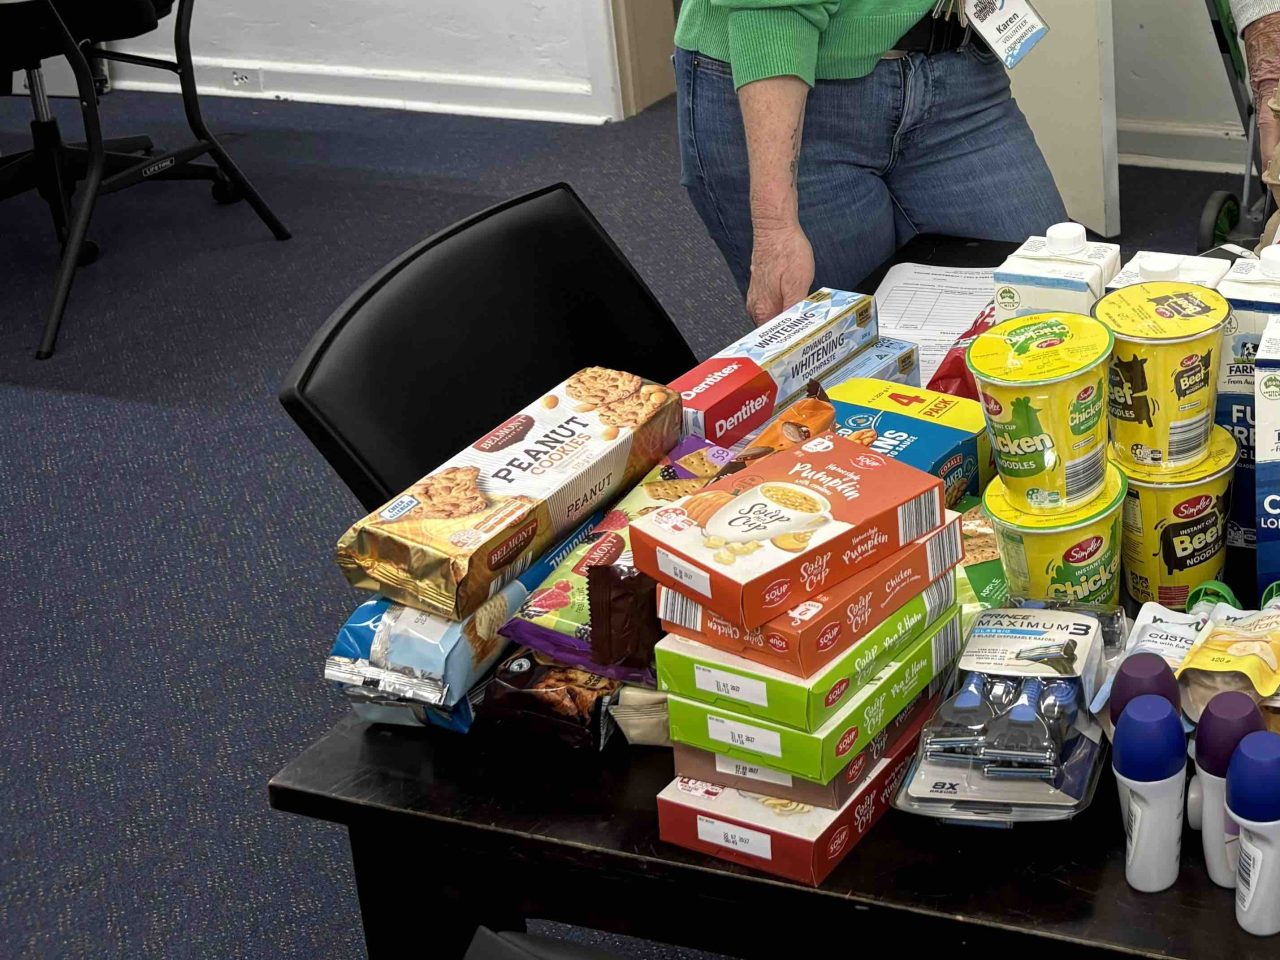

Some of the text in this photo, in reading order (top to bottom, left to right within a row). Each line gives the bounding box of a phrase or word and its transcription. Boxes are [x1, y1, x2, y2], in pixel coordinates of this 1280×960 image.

[995, 11, 1020, 35] Karen
[754, 312, 816, 349] WHITENING
[801, 330, 833, 357] ADVANCED
[791, 332, 845, 379] WHITENING
[801, 352, 837, 382] TOOTHPASTE
[680, 360, 742, 400] Dentitex
[714, 392, 771, 439] Dentitex
[887, 391, 928, 412] 4
[922, 399, 955, 419] PACK
[491, 415, 590, 484] PEANUT
[530, 432, 592, 476] COOKIES
[566, 472, 613, 518] PEANUT
[788, 462, 861, 502] Pumpkin
[490, 521, 537, 566] BELMONT
[841, 532, 890, 565] Pumpkin
[800, 551, 833, 583] Soup
[977, 620, 1092, 636] MAXIMUM 3
[981, 612, 1034, 621] PRINCE
[931, 780, 961, 792] 8X
